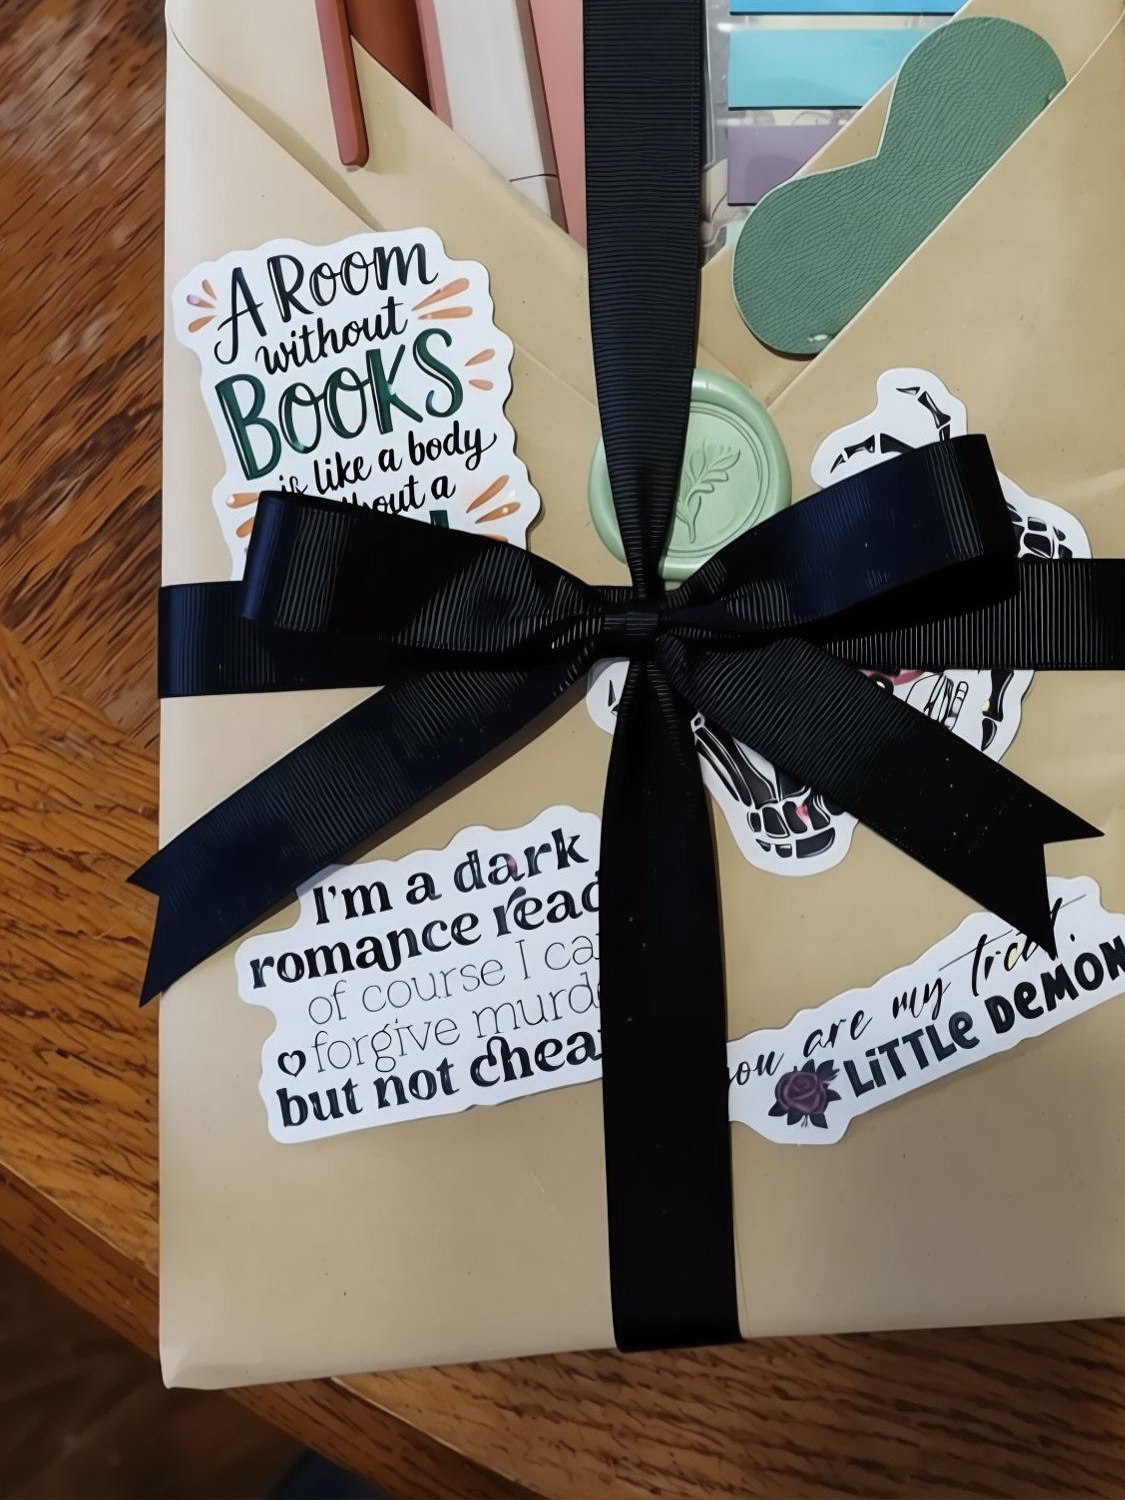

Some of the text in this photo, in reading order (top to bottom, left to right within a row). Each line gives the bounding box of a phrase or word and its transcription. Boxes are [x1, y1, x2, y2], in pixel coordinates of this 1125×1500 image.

[213, 266, 268, 365] A
[255, 295, 409, 375] without
[214, 327, 464, 481] BOOKS
[313, 451, 373, 496] like
[378, 448, 403, 473] a
[408, 419, 498, 472] body
[430, 475, 457, 501] a
[312, 827, 590, 926] I'm a dark
[249, 869, 601, 990] romance read
[307, 931, 600, 1025] of course I ca
[311, 972, 601, 1074] forgive murd
[727, 1047, 786, 1087] ou
[802, 1009, 873, 1059] are
[891, 977, 953, 1022] my
[275, 1078, 364, 1128] but
[373, 1056, 460, 1110] not
